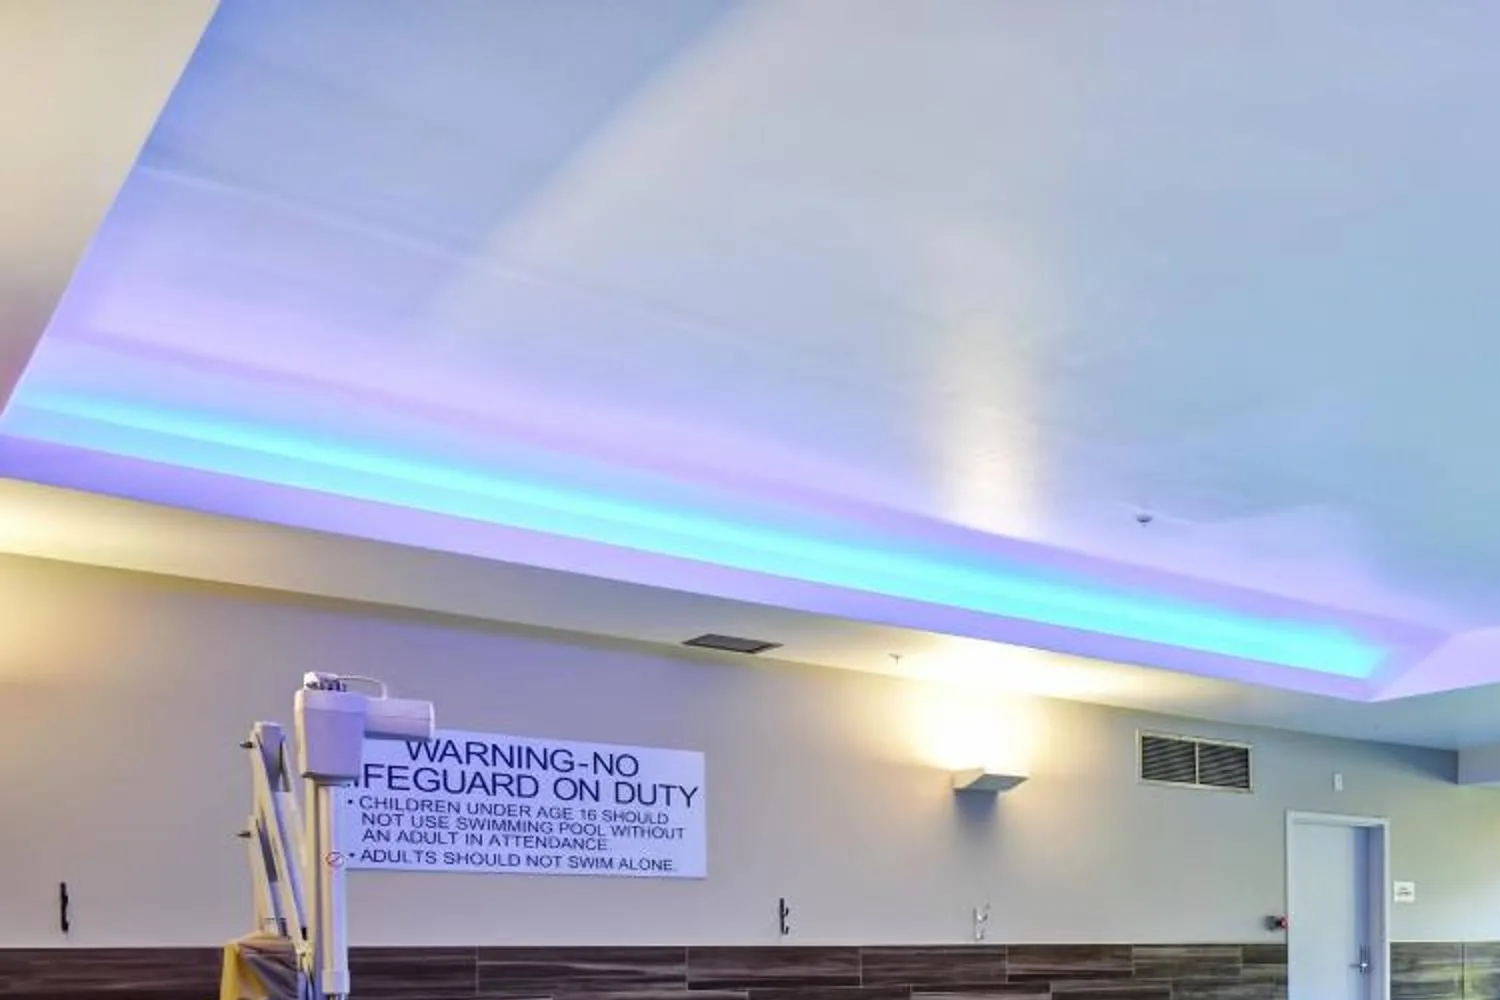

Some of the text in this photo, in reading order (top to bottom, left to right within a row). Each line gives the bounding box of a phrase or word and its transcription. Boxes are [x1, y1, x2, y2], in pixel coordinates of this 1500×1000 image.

[406, 739, 639, 777] WARNING-NO
[347, 763, 698, 808] FEGUARD ON DUTY
[359, 796, 669, 824] CHILDREN UNDER AGE 16 SHOULD
[361, 813, 684, 839] NOT USE SWIMMING POOL WITHOUT
[361, 829, 391, 842] AN
[396, 830, 458, 845] ADULT
[465, 834, 483, 846] IN
[360, 850, 437, 864] ADULTS
[443, 852, 521, 867] SHOULD
[526, 855, 562, 868] NOT
[567, 855, 613, 869] SWIM
